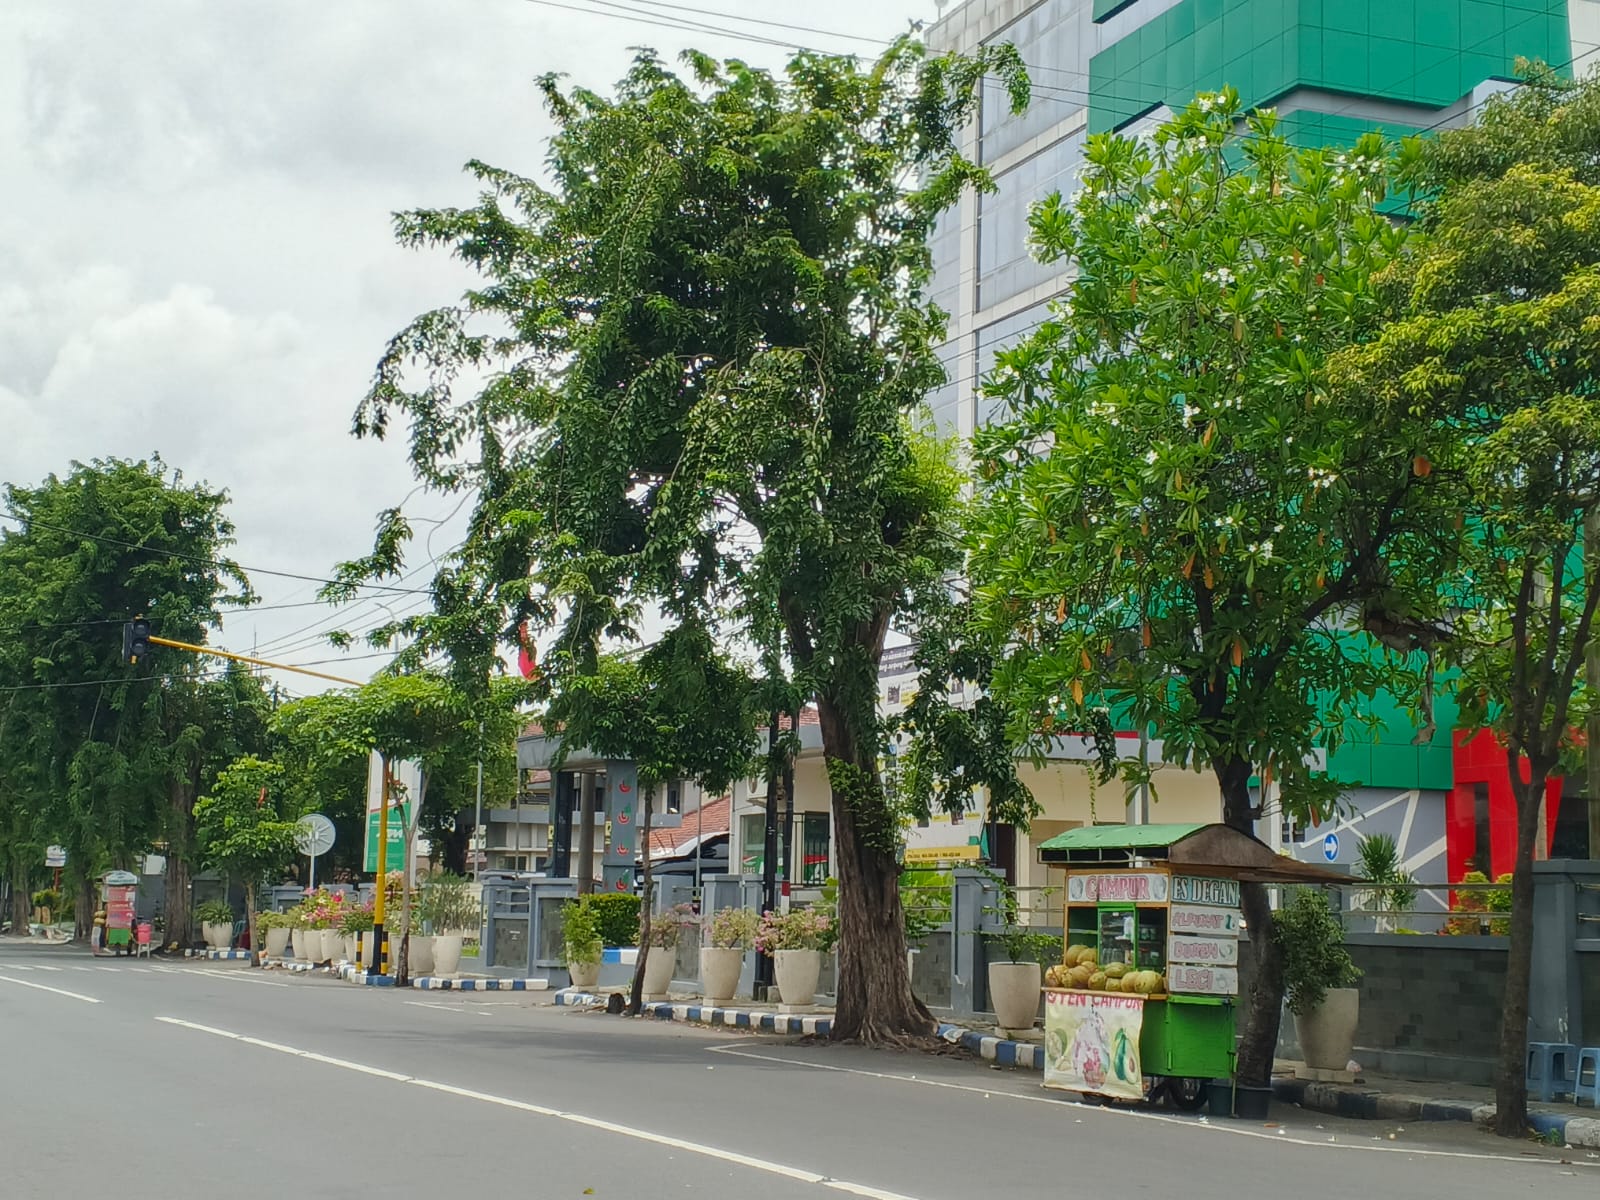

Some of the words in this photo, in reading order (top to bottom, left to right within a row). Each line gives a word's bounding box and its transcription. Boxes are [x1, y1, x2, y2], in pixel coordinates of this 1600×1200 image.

[1085, 875, 1150, 900] CAMPUR
[1172, 876, 1189, 901] ES
[1191, 878, 1237, 905] DEGAN
[1172, 911, 1224, 929] ALPUKAT
[1175, 968, 1214, 991] LECI
